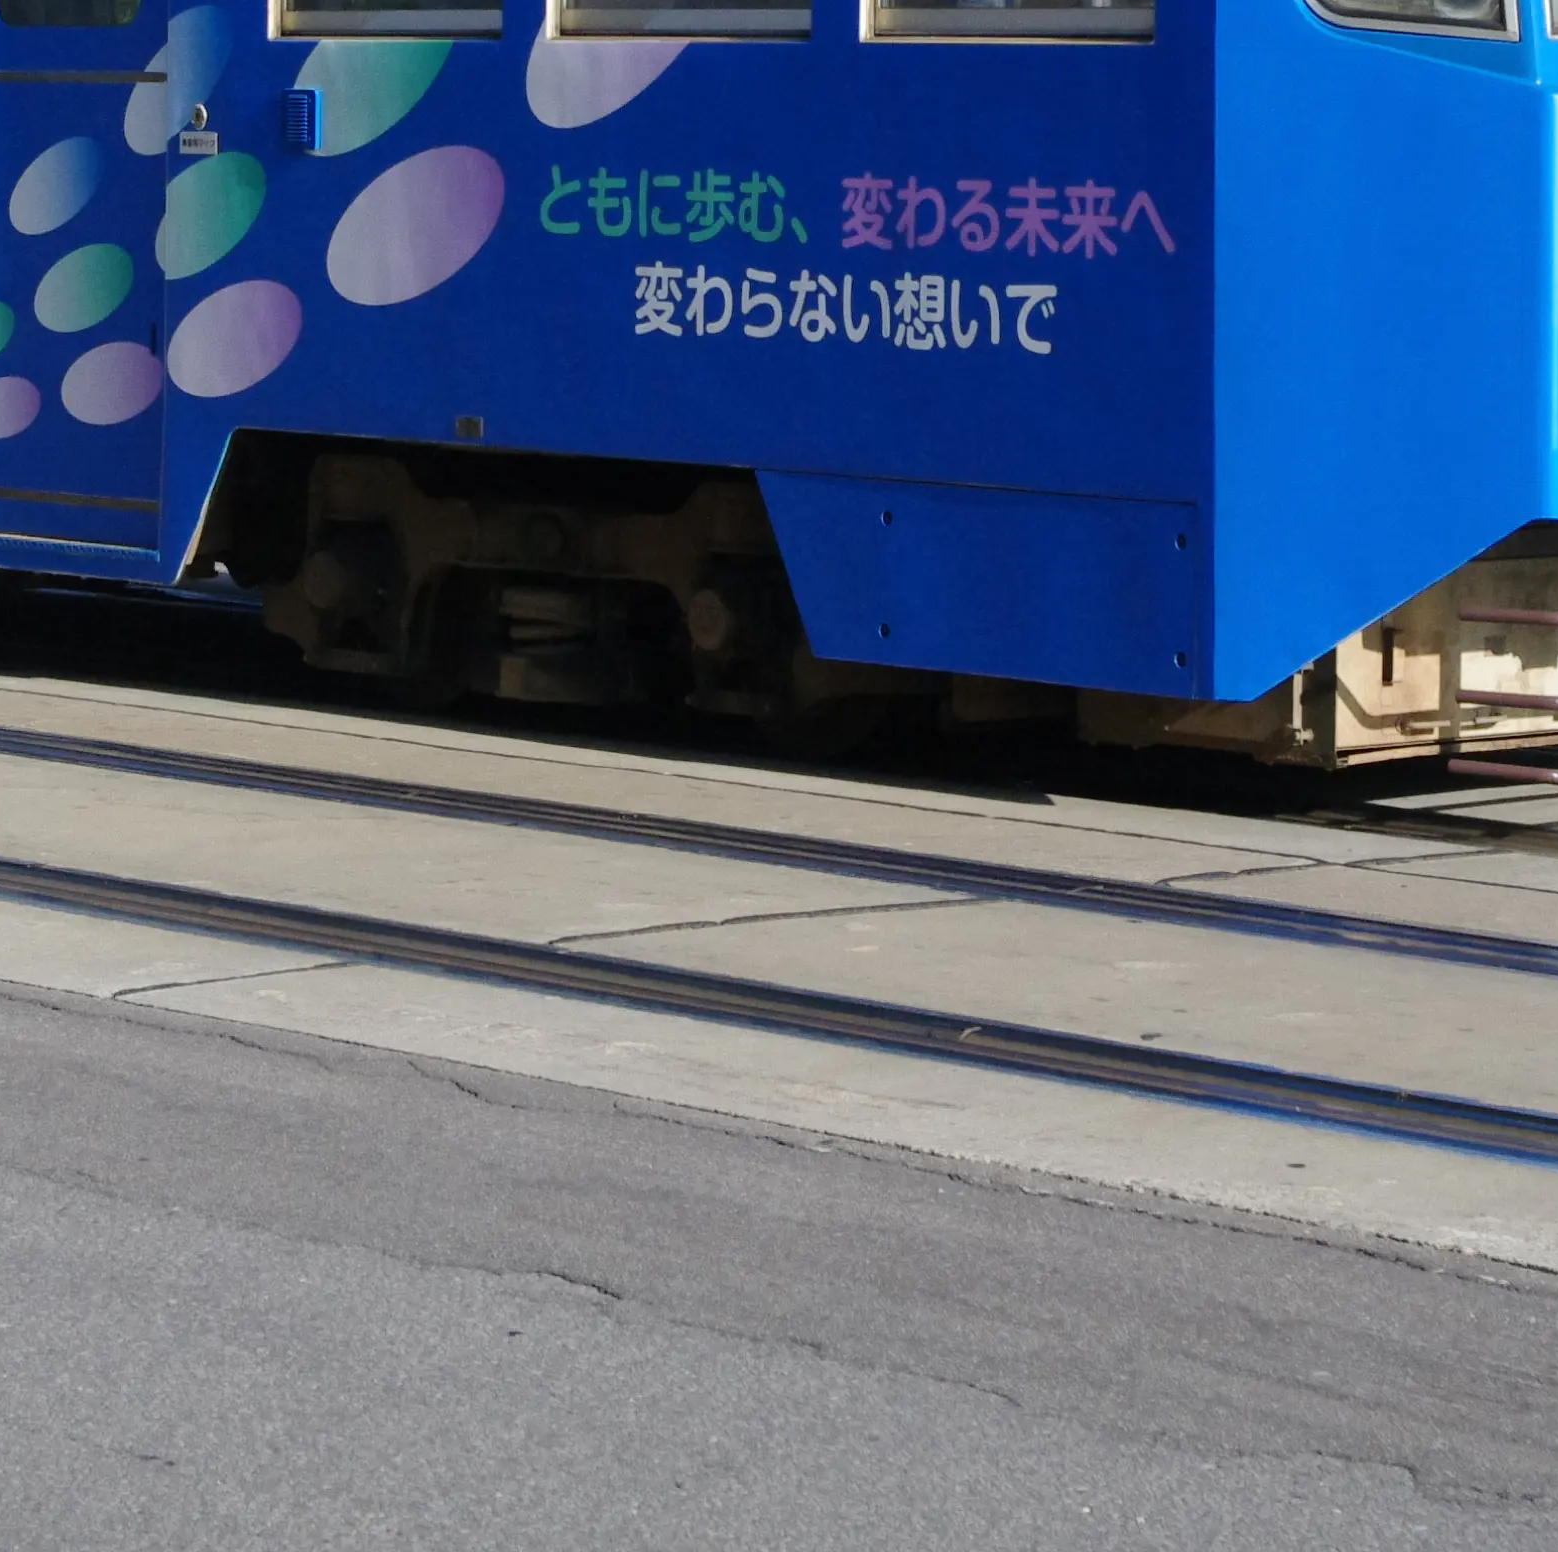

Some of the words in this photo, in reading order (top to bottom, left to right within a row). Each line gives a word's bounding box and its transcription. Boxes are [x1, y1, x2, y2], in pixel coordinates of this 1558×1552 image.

[634, 260, 1058, 355] 変わらない想いで
